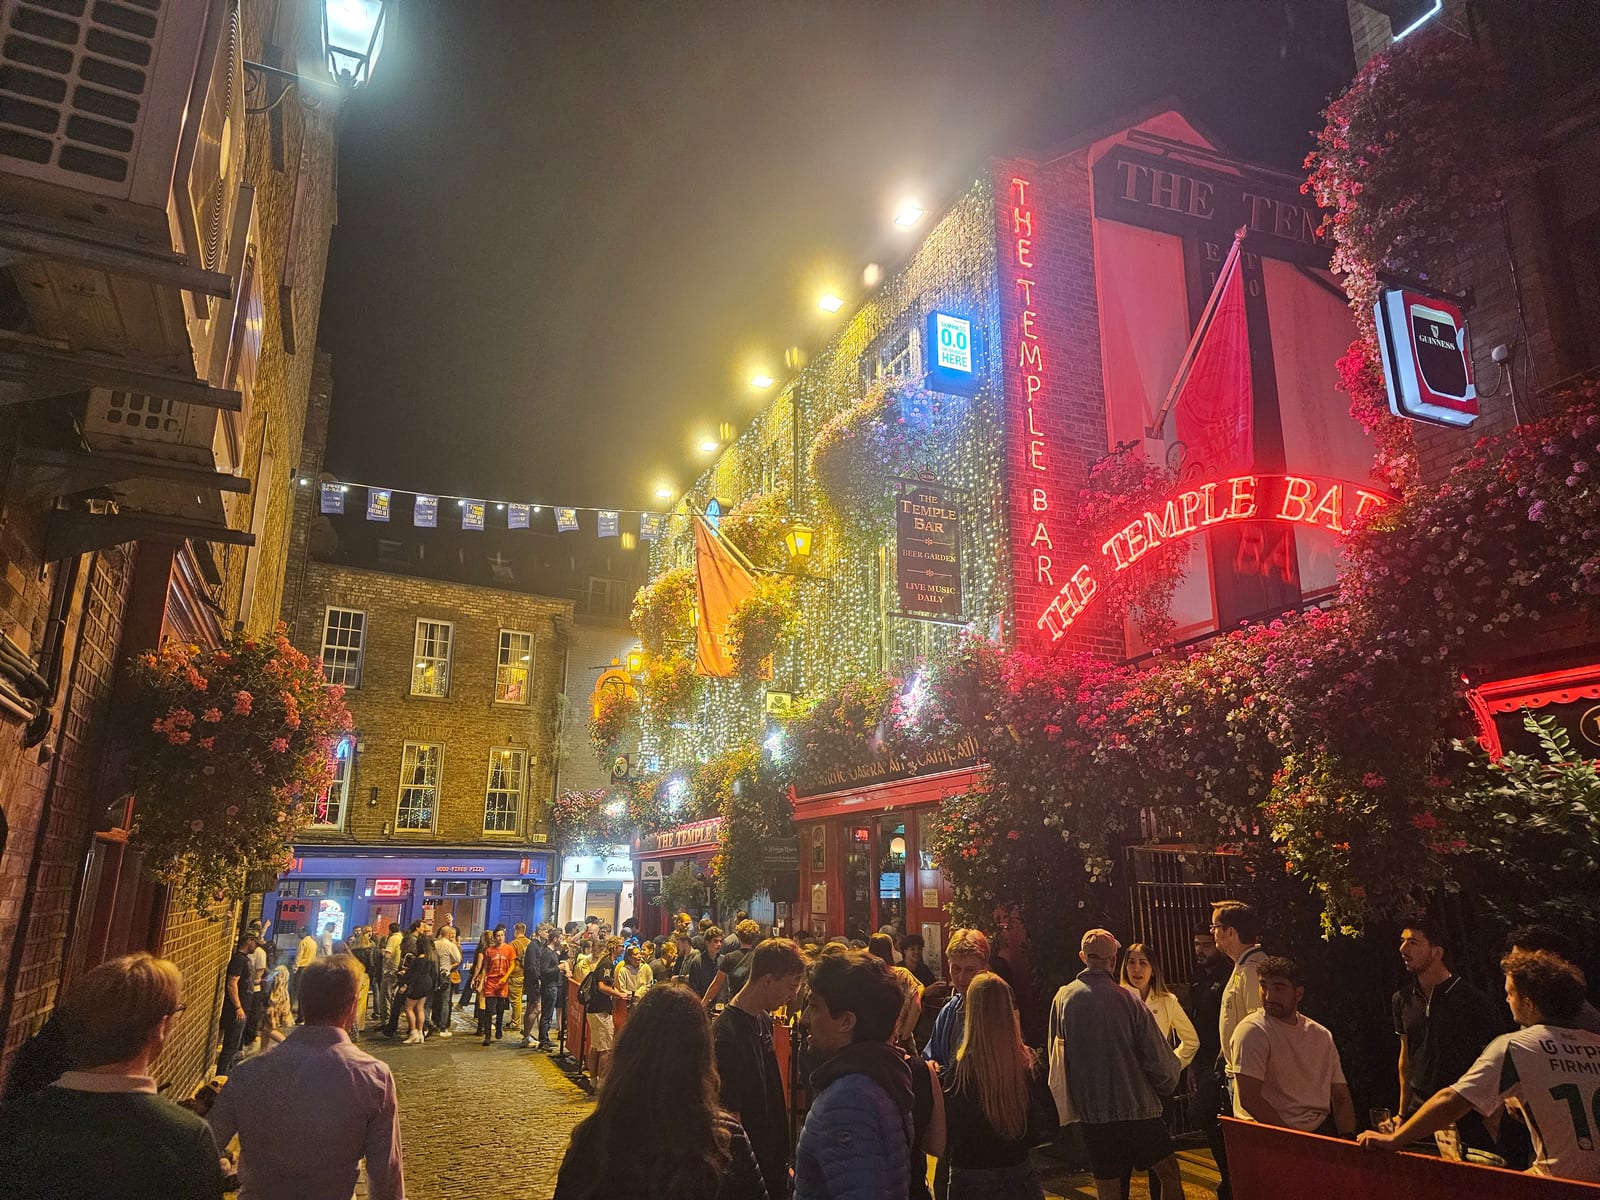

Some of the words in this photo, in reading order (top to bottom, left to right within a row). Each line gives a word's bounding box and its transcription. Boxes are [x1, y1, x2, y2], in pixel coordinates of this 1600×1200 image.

[1117, 160, 1215, 220] THE
[1012, 178, 1032, 268] THE
[941, 328, 967, 350] 0.0
[1418, 334, 1456, 351] GUINNESS
[942, 352, 968, 368] HERE
[1017, 278, 1046, 470] TEMPLE
[919, 494, 938, 504] THE
[900, 500, 957, 520] TEMPLE
[914, 518, 945, 533] BAR
[1031, 488, 1053, 586] BAR
[902, 549, 923, 559] BEER
[924, 552, 957, 563] GARDEN
[1037, 565, 1097, 641] THE
[1102, 475, 1256, 572] TEMPLE
[905, 582, 926, 592] LIVE
[927, 585, 956, 595] MUSIC
[917, 594, 945, 604] DAILY
[657, 833, 674, 848] THE
[676, 826, 712, 846] TEMPLE
[1561, 1043, 1600, 1058] urp
[1549, 1059, 1600, 1075] FIRMI
